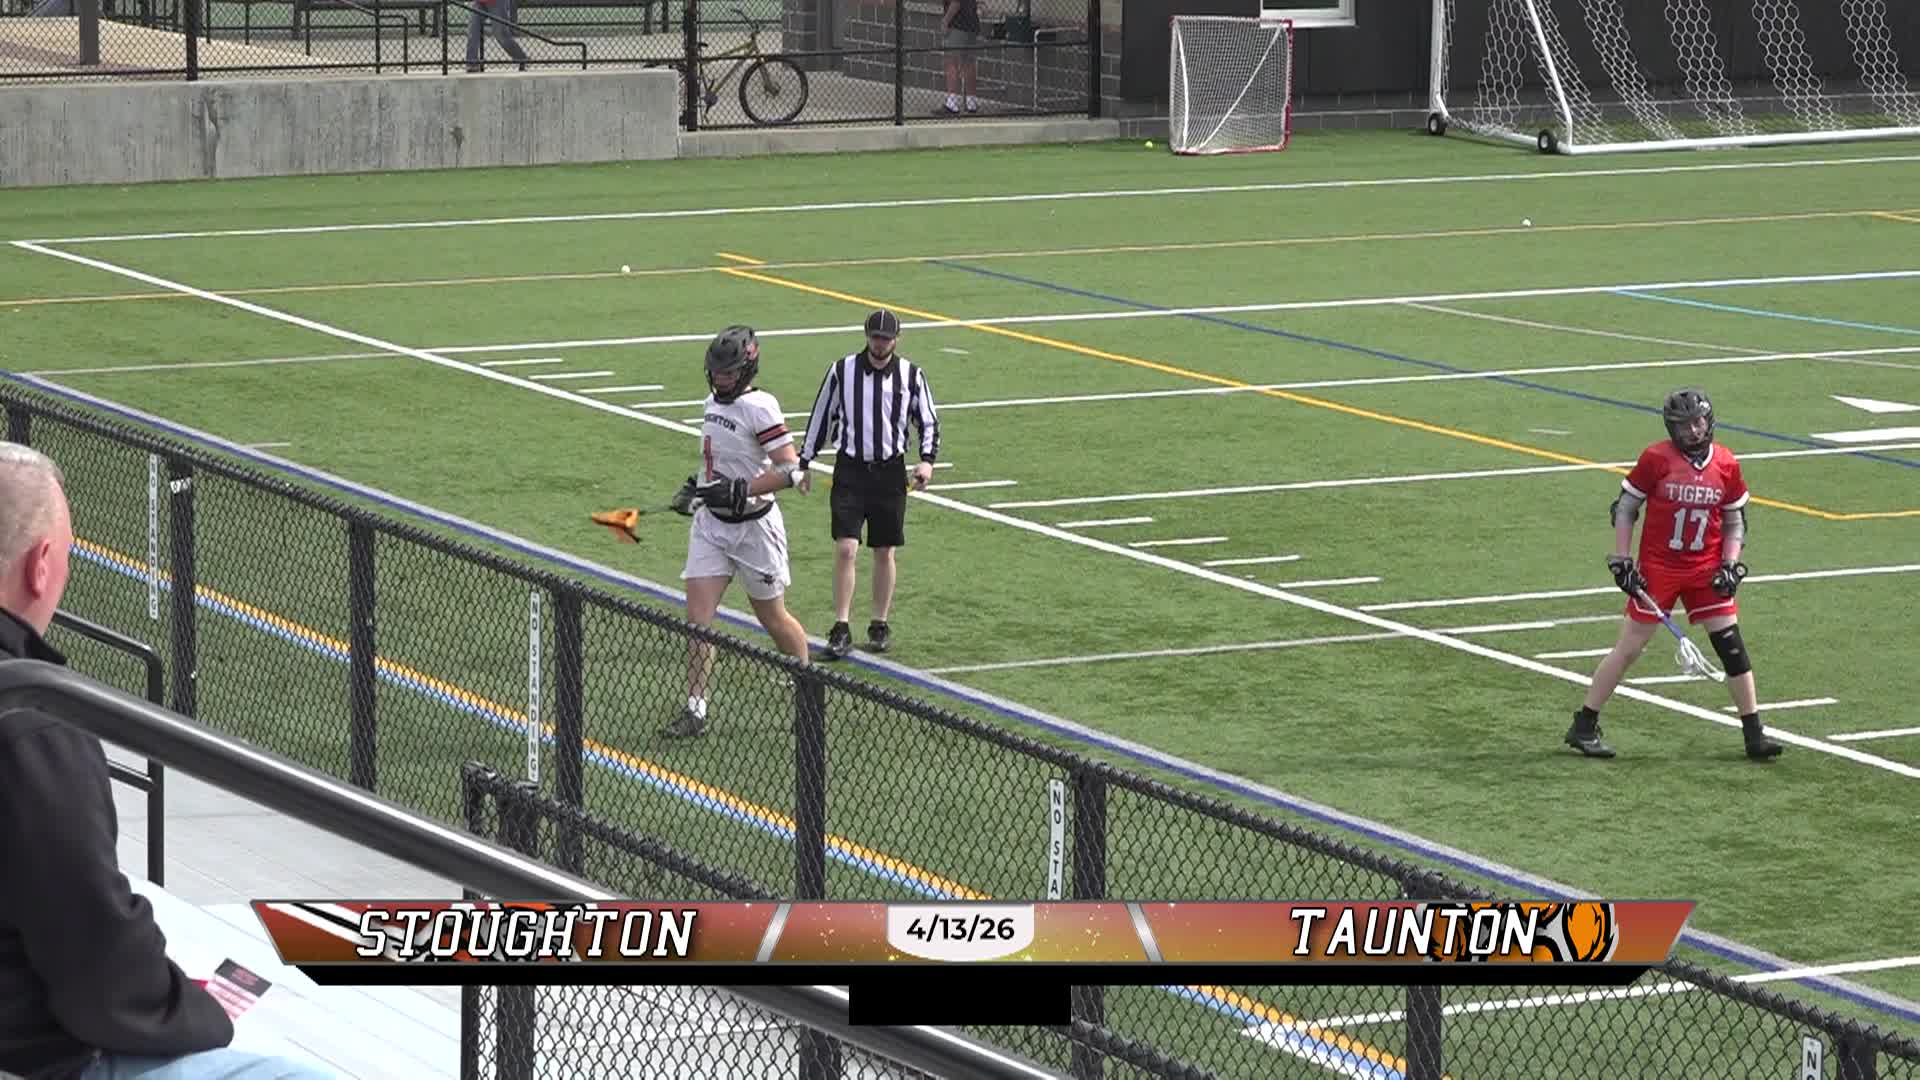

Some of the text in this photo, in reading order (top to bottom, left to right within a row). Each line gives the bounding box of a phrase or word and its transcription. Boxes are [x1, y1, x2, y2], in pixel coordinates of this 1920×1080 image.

[150, 463, 157, 488] NO
[1664, 483, 1723, 505] TIGERS
[1668, 507, 1710, 551] 17
[529, 600, 538, 770] NO STANDING
[1050, 790, 1062, 902] NO STA
